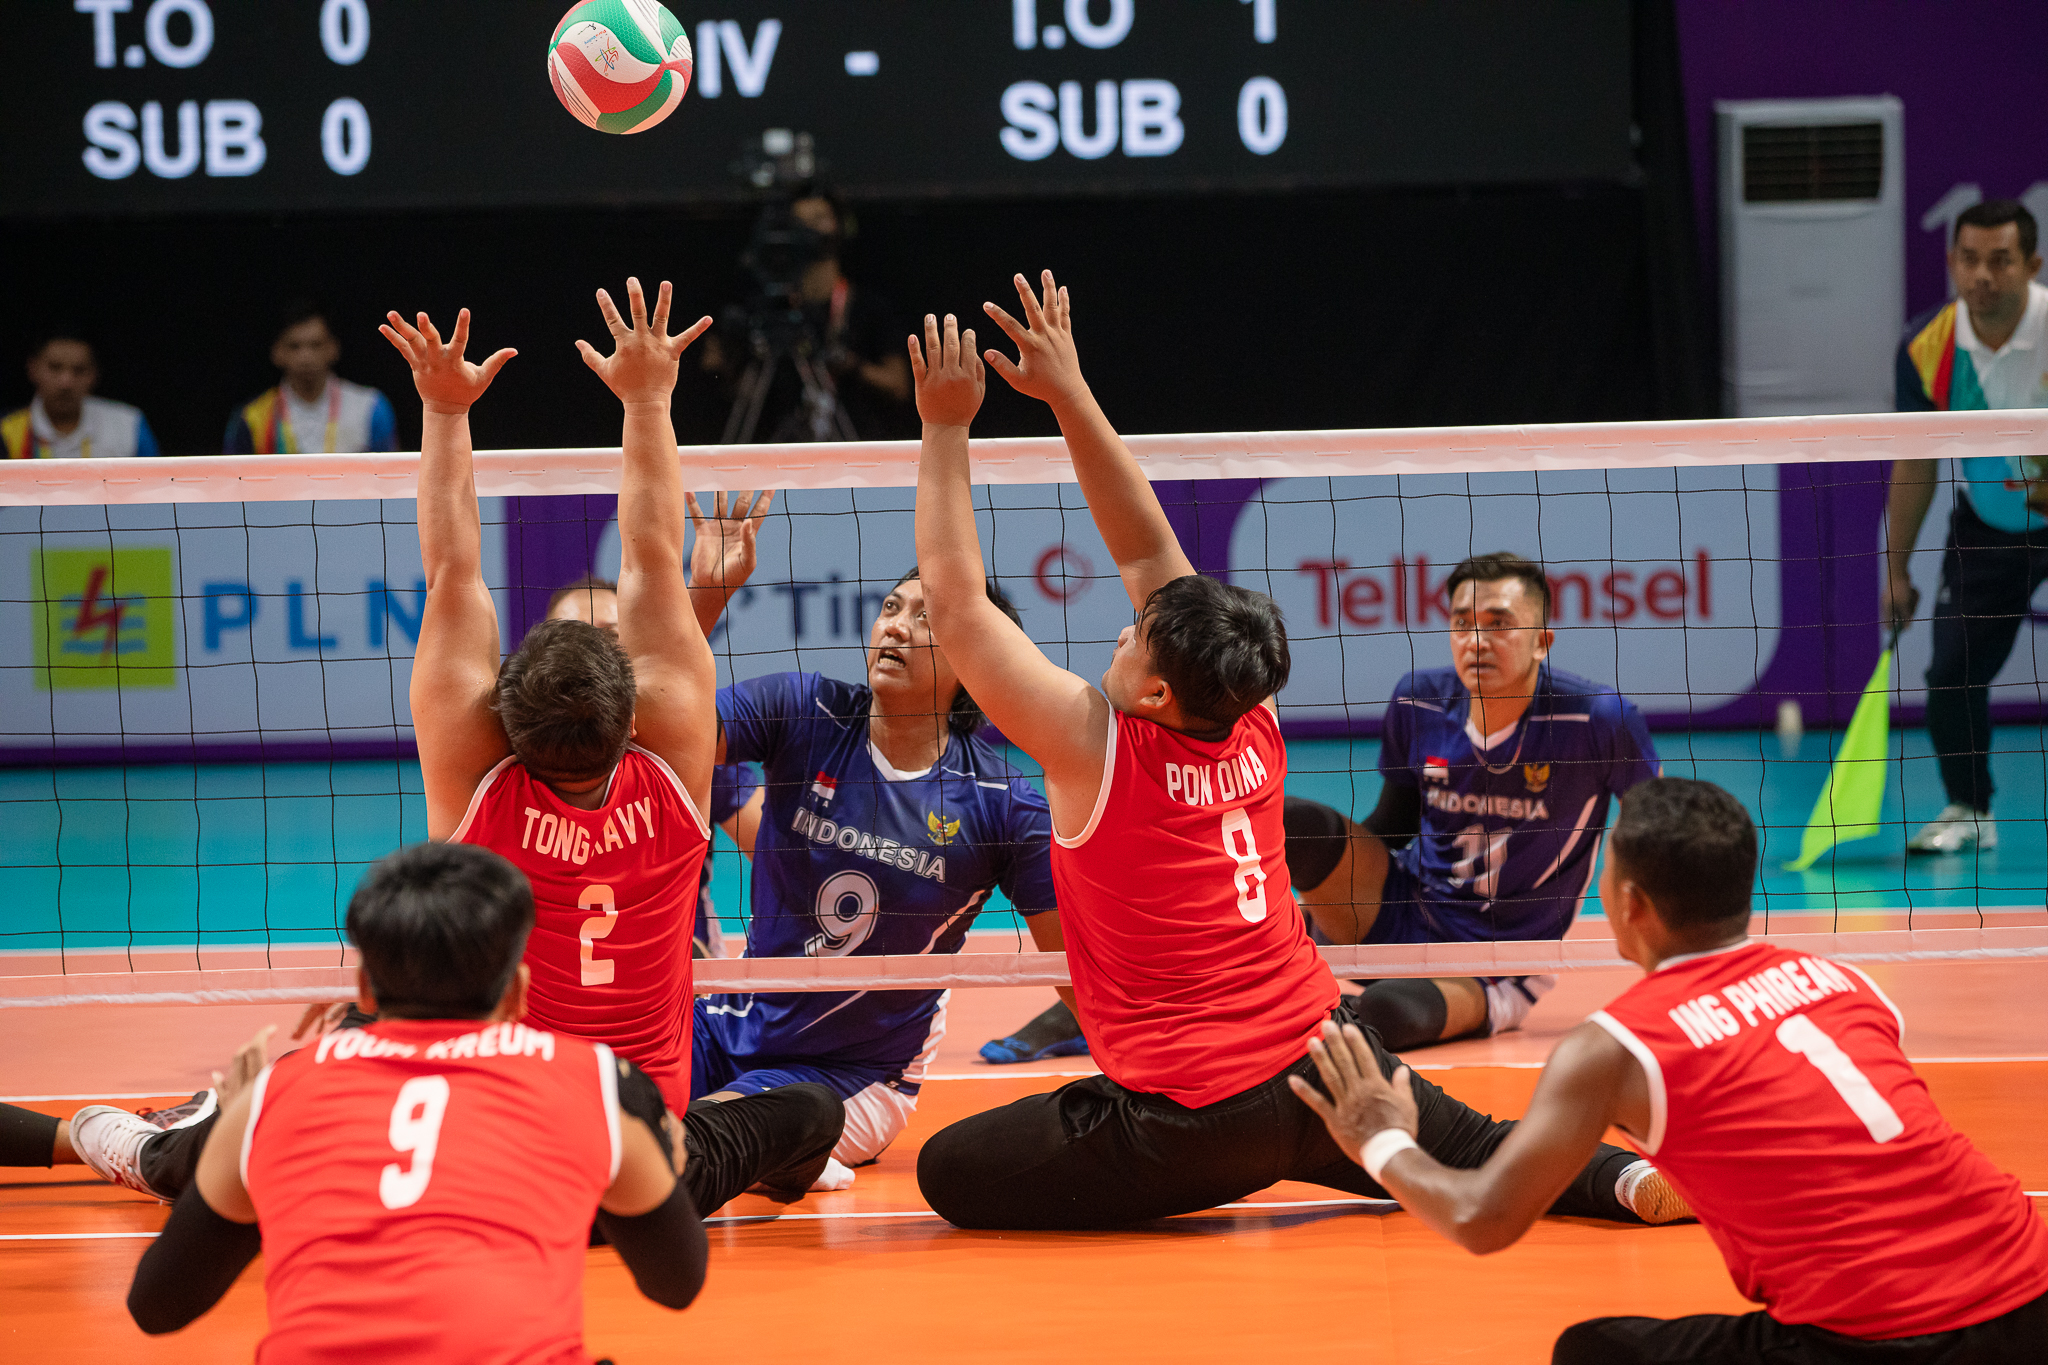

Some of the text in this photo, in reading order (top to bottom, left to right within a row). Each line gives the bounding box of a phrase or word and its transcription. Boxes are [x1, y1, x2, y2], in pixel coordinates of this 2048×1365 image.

[73, 0, 371, 68] T.O 0
[82, 96, 372, 180] SUB 0
[1000, 75, 1289, 161] SUB 0
[203, 576, 426, 653] PLN
[1296, 547, 1715, 629] Telkmsel
[1217, 745, 1268, 802] DINA
[791, 806, 946, 883] INDONESIA
[1222, 807, 1268, 923] 8
[577, 884, 619, 987] 2
[805, 869, 880, 957] 9
[1668, 994, 1740, 1049] ING
[1775, 1013, 1905, 1144] 1
[379, 1074, 450, 1210] 9
